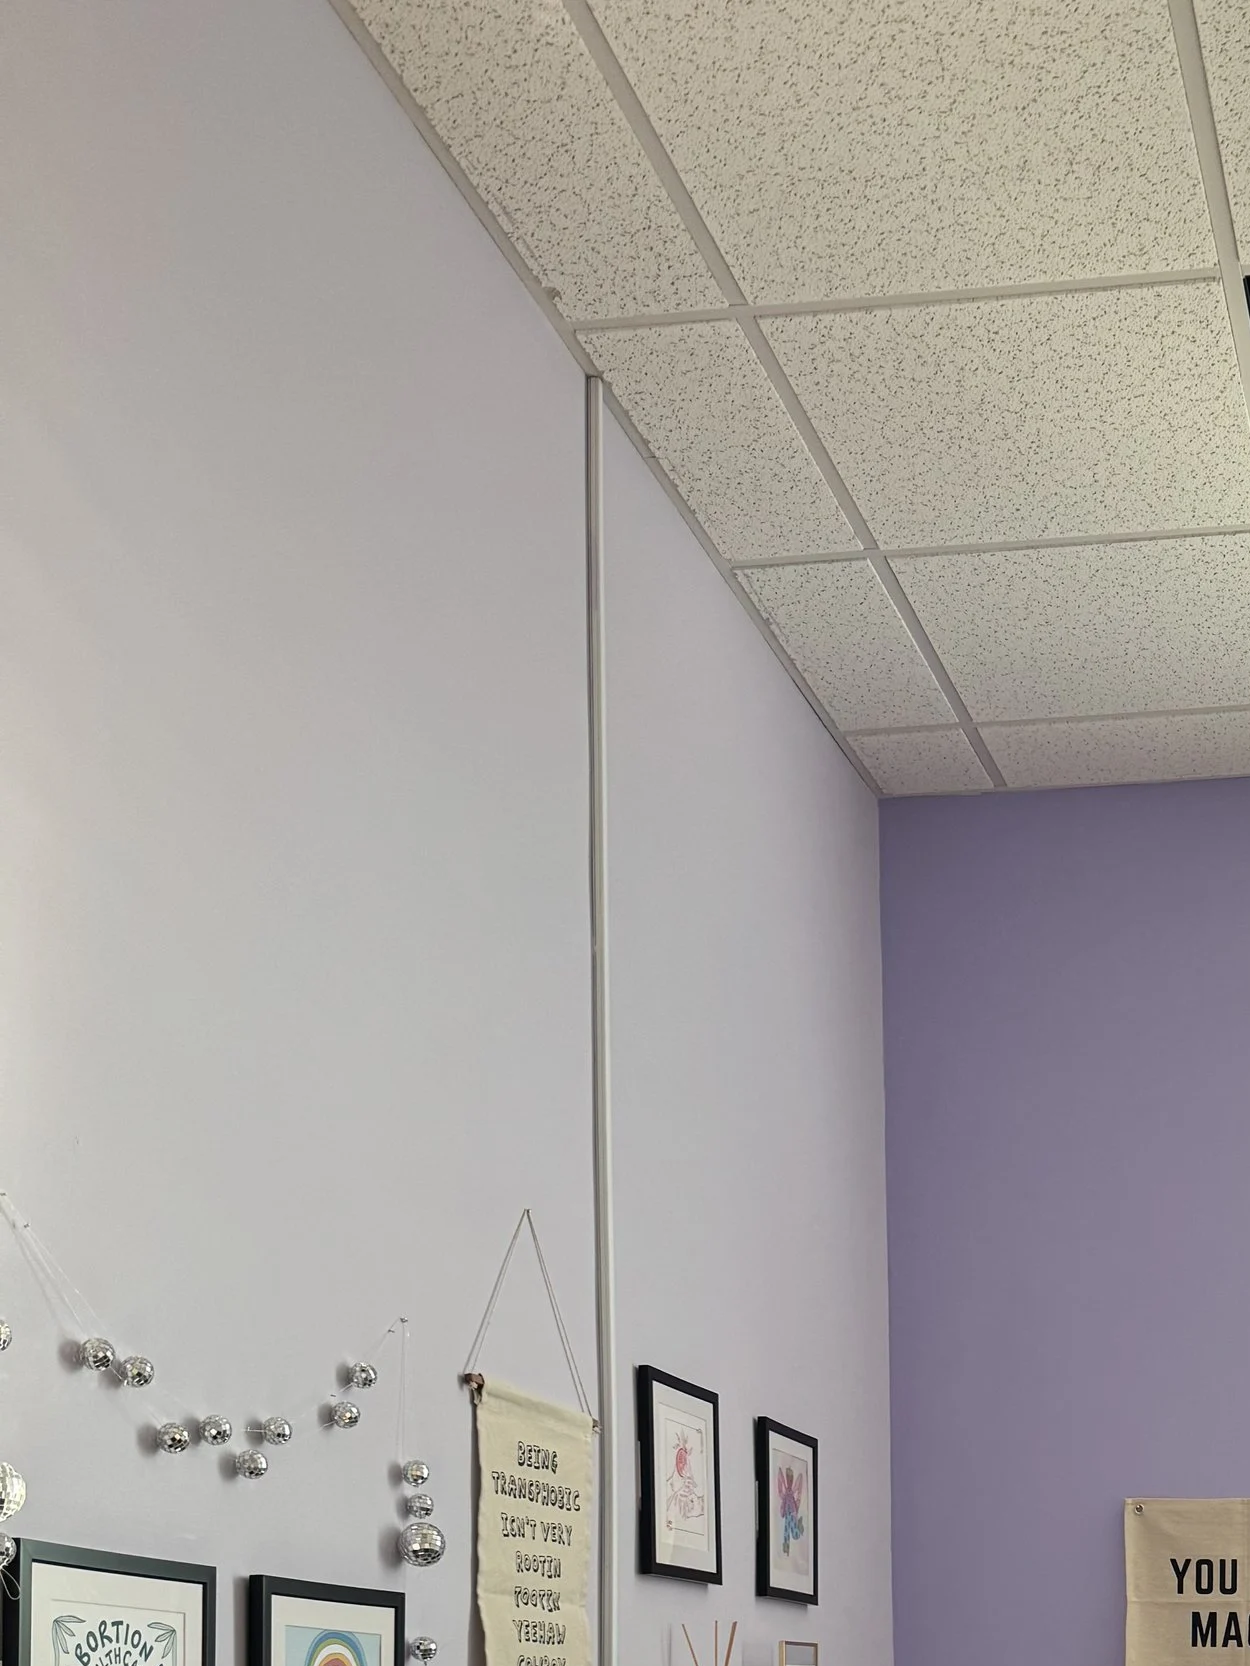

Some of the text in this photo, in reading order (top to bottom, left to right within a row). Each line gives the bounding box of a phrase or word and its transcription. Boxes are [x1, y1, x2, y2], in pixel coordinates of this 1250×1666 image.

[517, 1441, 558, 1474] BEING
[491, 1471, 581, 1511] TRANSPHOBIC
[500, 1512, 573, 1546] ISN'T VERY
[515, 1550, 561, 1579] ROOTIN
[1169, 1558, 1238, 1595] YOU
[514, 1586, 561, 1612] TOOTIN
[512, 1619, 567, 1645] YEEHAW
